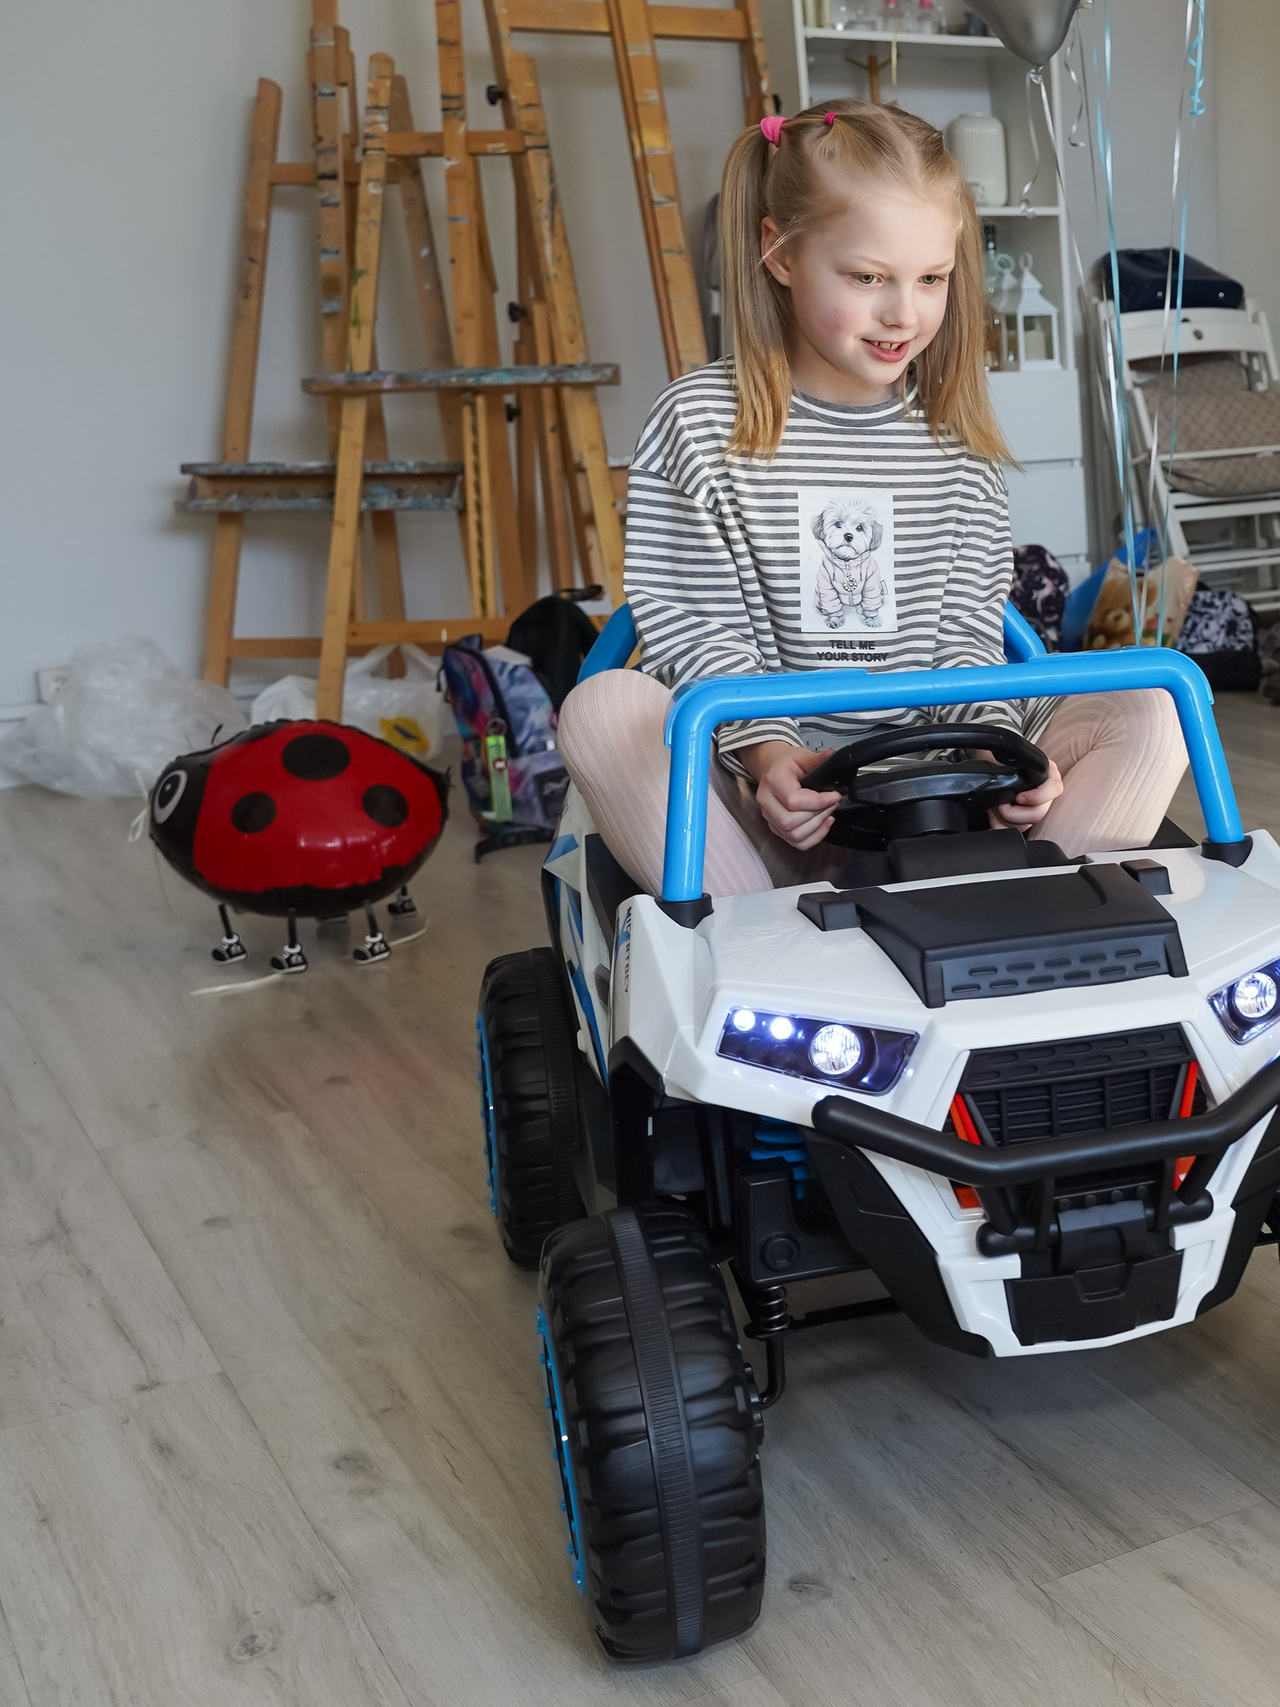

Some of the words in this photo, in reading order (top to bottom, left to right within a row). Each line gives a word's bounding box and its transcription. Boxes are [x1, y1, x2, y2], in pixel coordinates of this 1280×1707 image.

[829, 639, 856, 650] TELL
[859, 640, 876, 650] ME
[816, 651, 849, 661] YOUR
[851, 652, 889, 662] STORY
